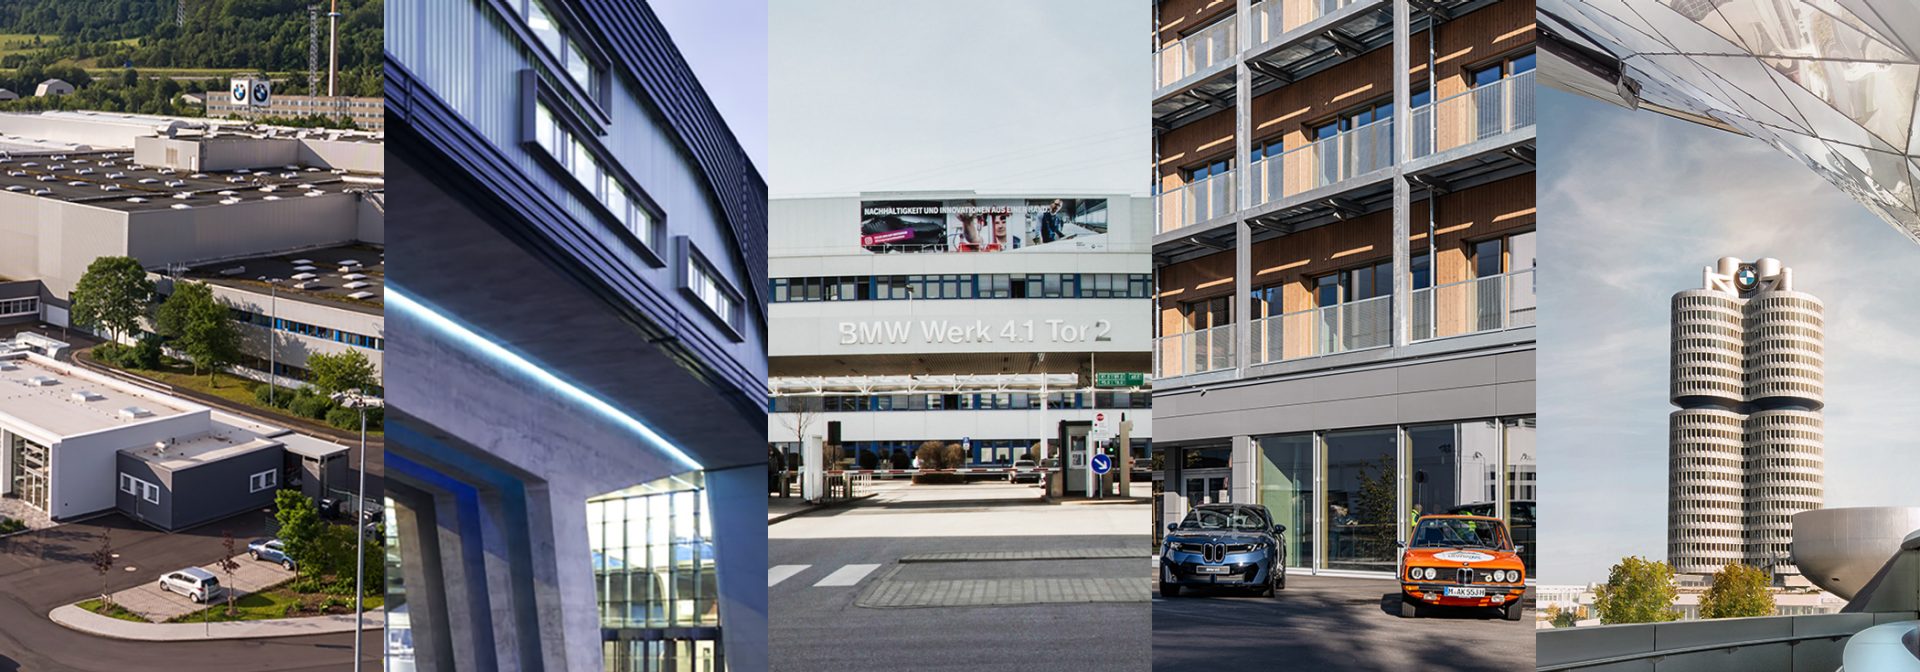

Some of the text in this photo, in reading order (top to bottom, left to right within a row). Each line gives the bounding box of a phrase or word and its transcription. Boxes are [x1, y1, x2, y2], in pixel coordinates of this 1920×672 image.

[864, 207, 923, 215] NACHHALTIGKEIT
[924, 206, 939, 214] UND
[940, 206, 990, 214] INNOVATIONEN
[991, 206, 1006, 214] AUS
[839, 319, 1112, 345] BMW Werk 4.1 Tor 2
